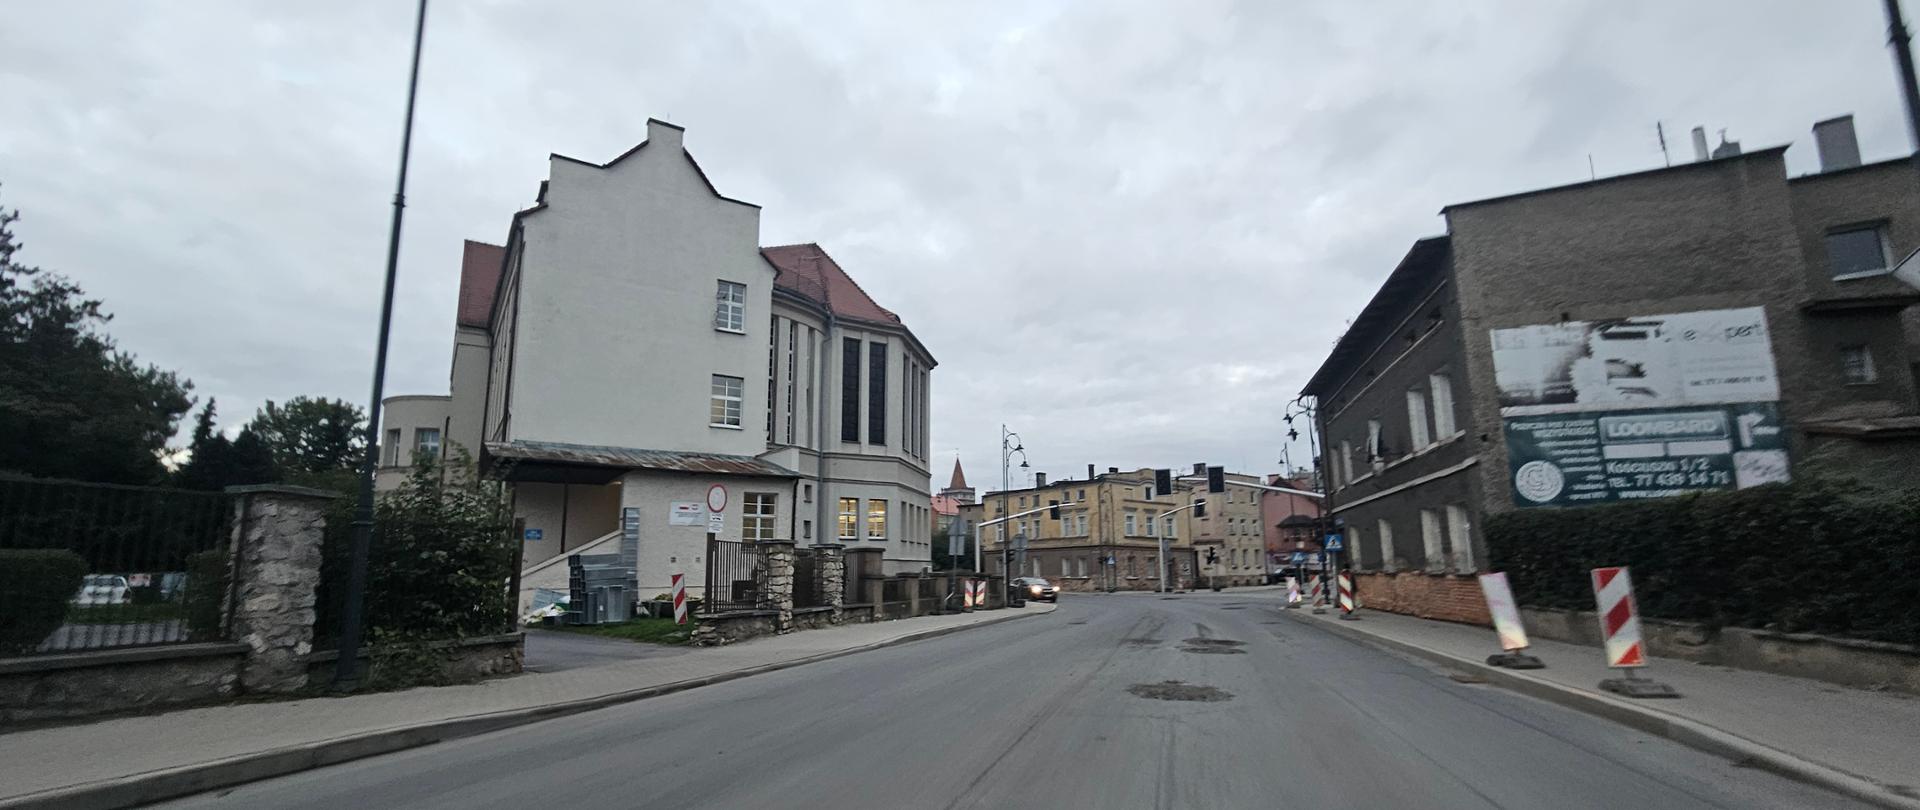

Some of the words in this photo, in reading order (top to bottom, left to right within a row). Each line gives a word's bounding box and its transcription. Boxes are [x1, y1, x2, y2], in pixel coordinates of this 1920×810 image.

[1607, 418, 1717, 437] LOOMBARD
[1680, 457, 1710, 472] 1/2
[1634, 474, 1652, 487] 77
[1688, 471, 1709, 485] 14
